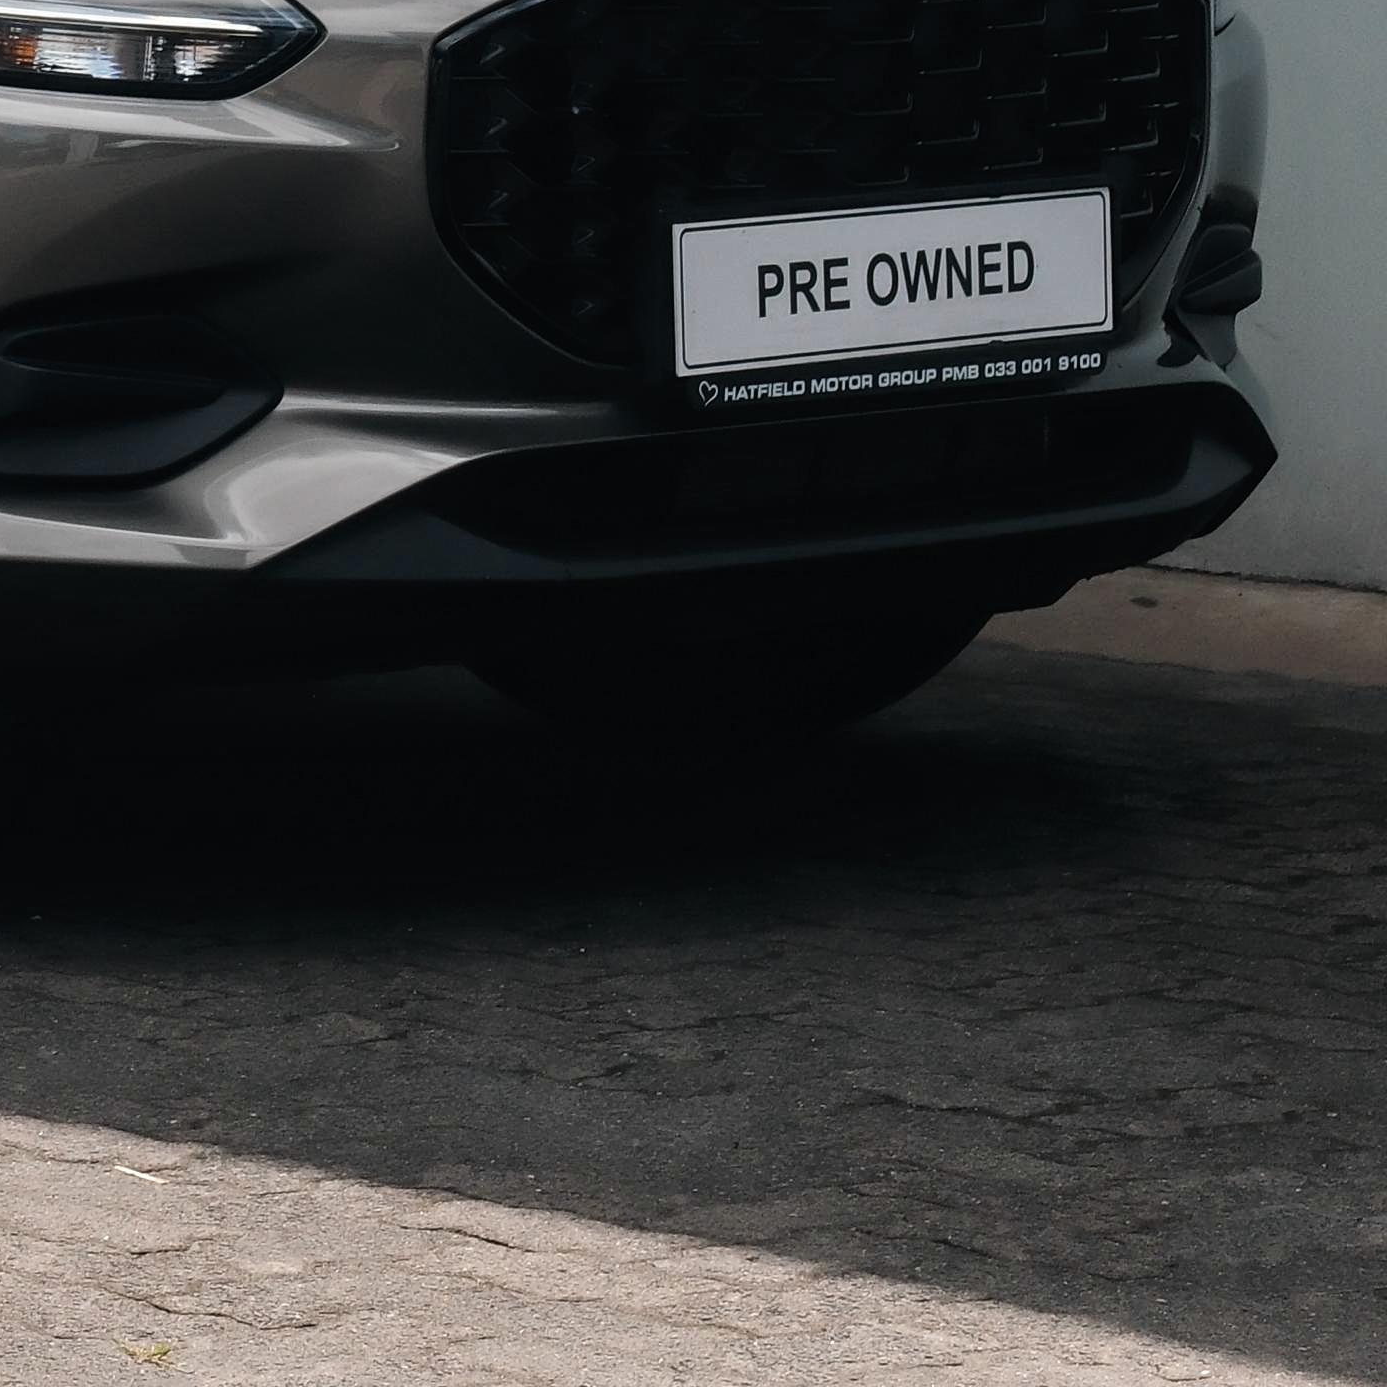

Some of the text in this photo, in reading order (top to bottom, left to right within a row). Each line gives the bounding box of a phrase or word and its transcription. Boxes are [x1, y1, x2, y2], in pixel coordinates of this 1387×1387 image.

[757, 240, 1035, 318] PRE OWNED
[724, 380, 806, 402] HATFIELD
[810, 374, 873, 394] MOTOR
[878, 369, 937, 388] GROUP
[942, 365, 979, 382] PMB
[984, 361, 1016, 377] 033
[1021, 357, 1051, 374] 001
